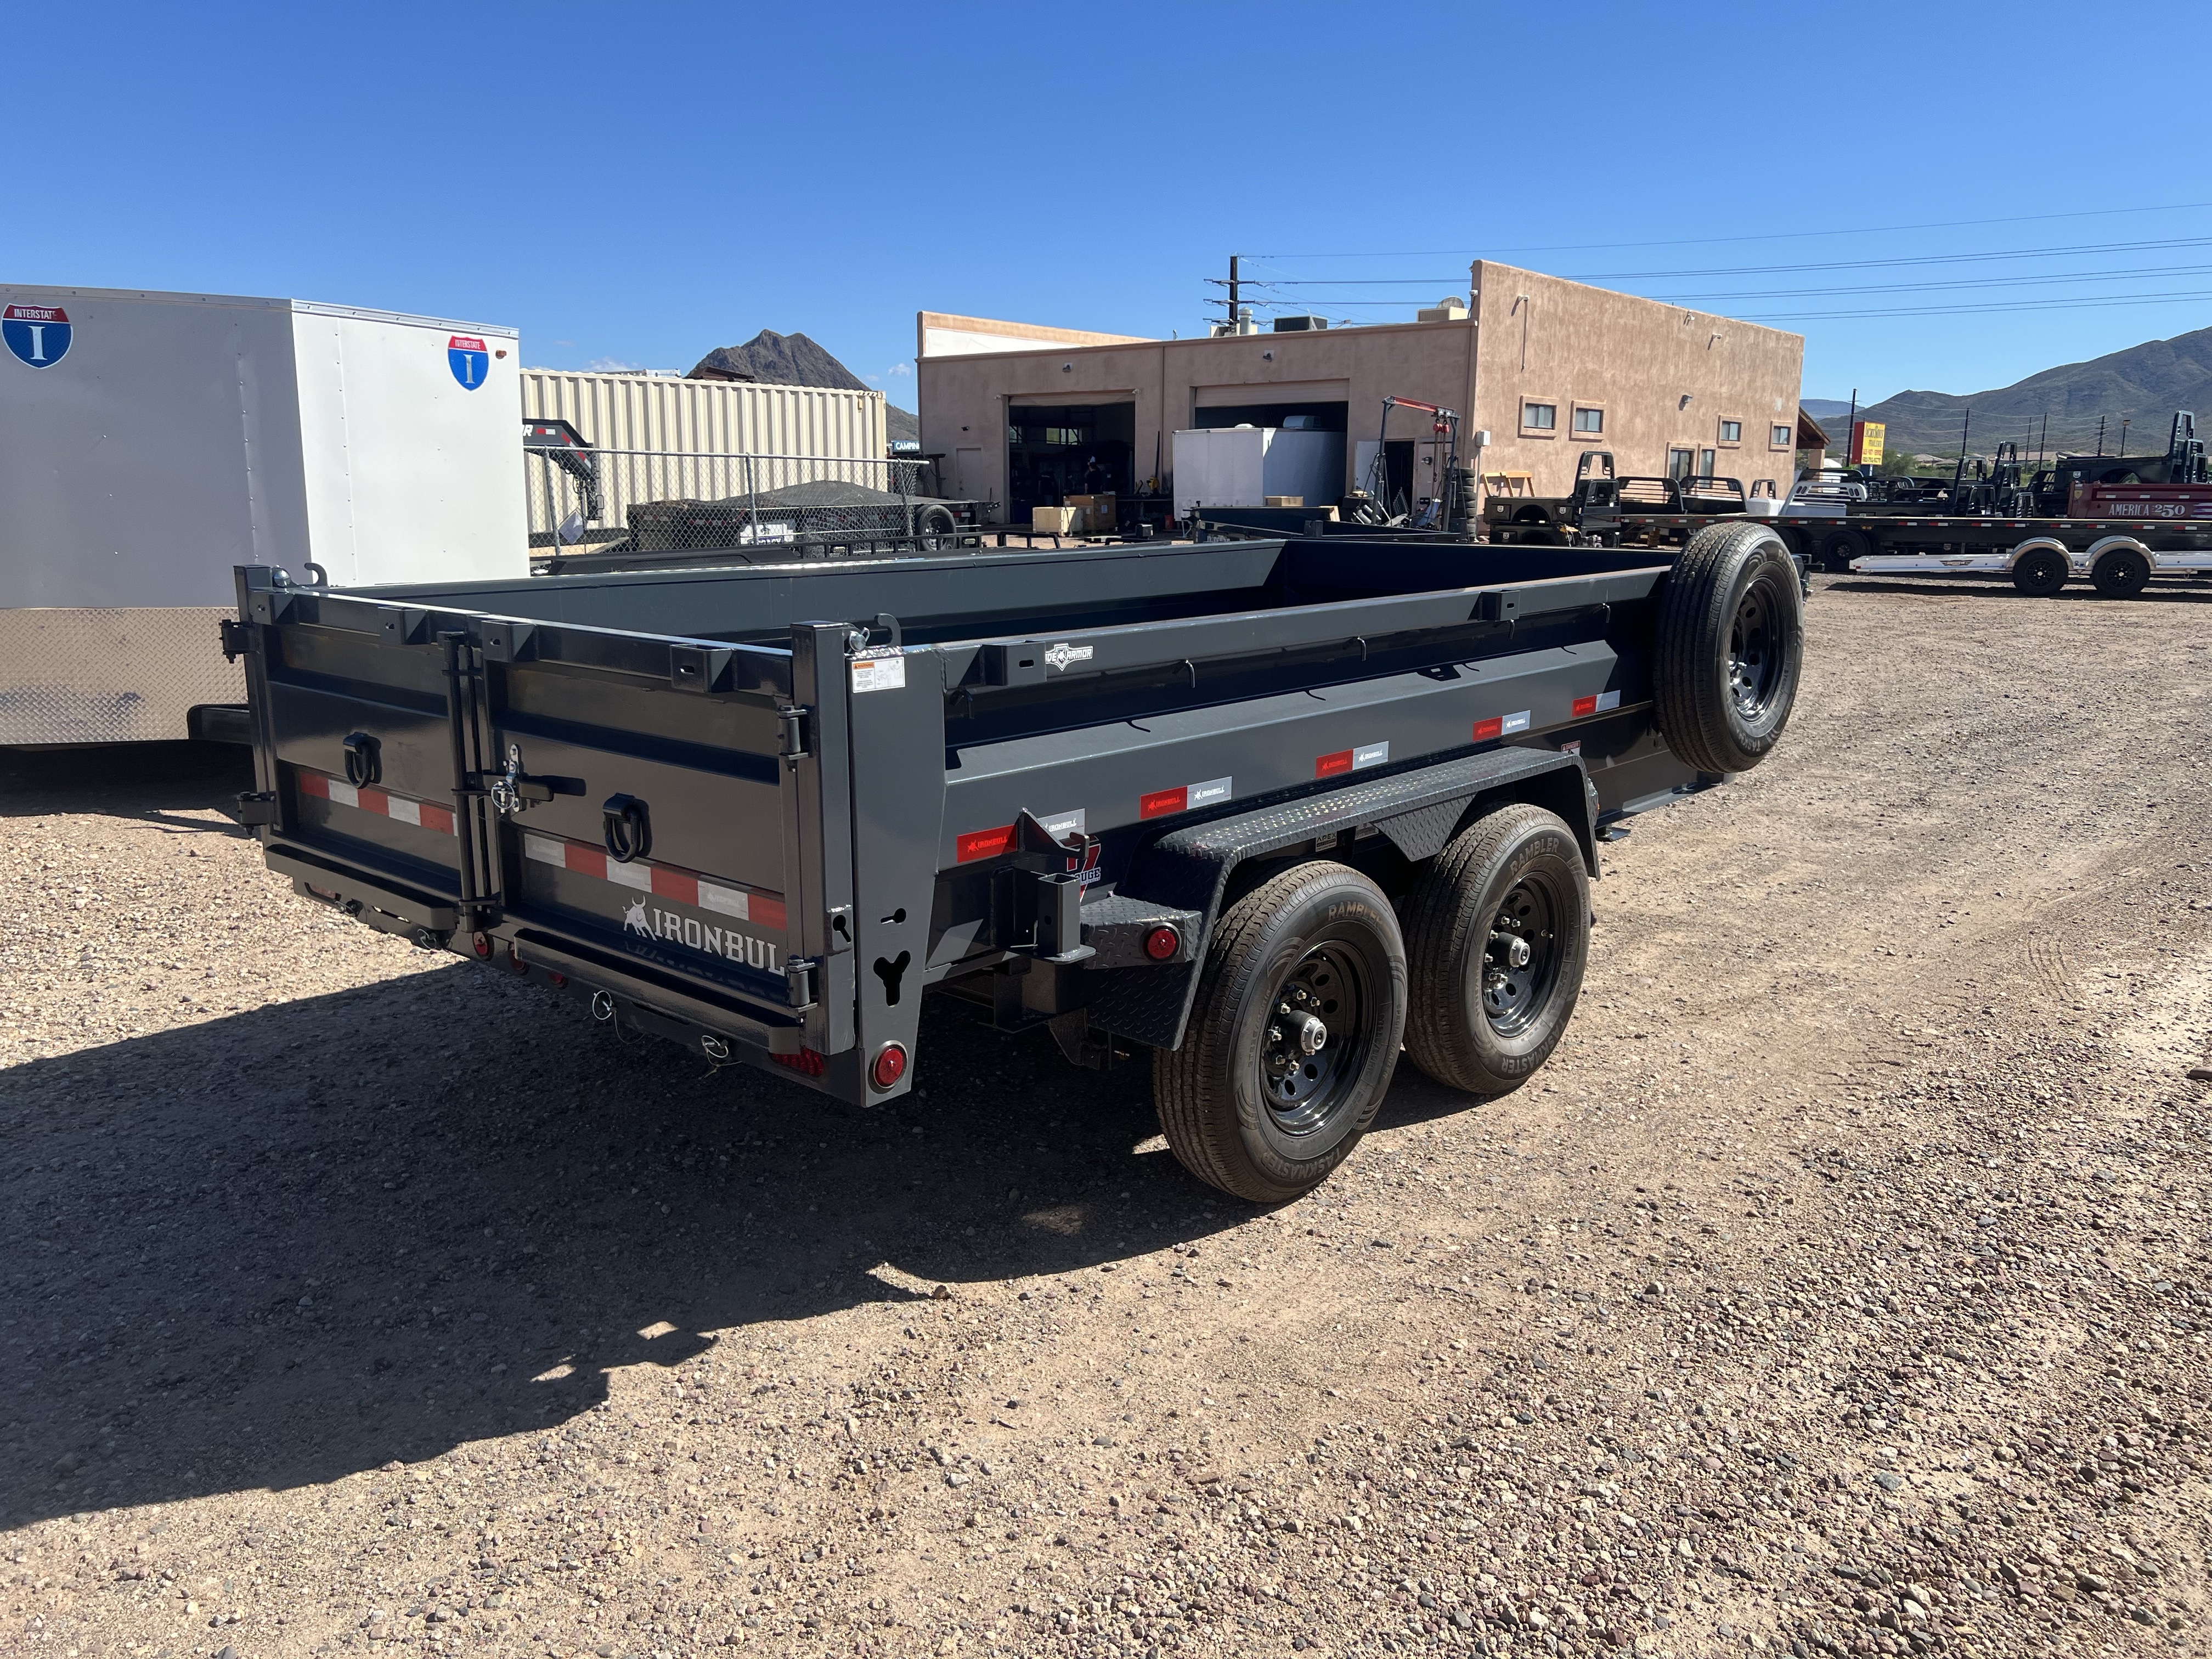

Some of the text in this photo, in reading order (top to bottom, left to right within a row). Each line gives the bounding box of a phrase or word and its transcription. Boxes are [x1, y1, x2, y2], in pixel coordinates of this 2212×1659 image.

[27, 325, 48, 360] I
[455, 339, 481, 349] INTERSTATE
[463, 354, 475, 383] I
[2108, 504, 2149, 516] AMERICA
[2154, 504, 2186, 517] 250
[1045, 648, 1092, 662] IDE ARMOR
[1201, 787, 1225, 797] IRONBULL
[1155, 796, 1181, 807] IRONBULL
[1048, 820, 1077, 832] IRONBULL
[978, 836, 1008, 848] IRONBULL
[1317, 832, 1336, 843] APEX
[1510, 837, 1560, 877] RAMBLER
[1075, 868, 1100, 882] UGE
[1328, 900, 1384, 929] RAMBLER
[653, 908, 787, 978] IRONBUL
[1501, 1018, 1567, 1074] TASKMASTER
[1262, 1147, 1343, 1180] TASKMASTER
